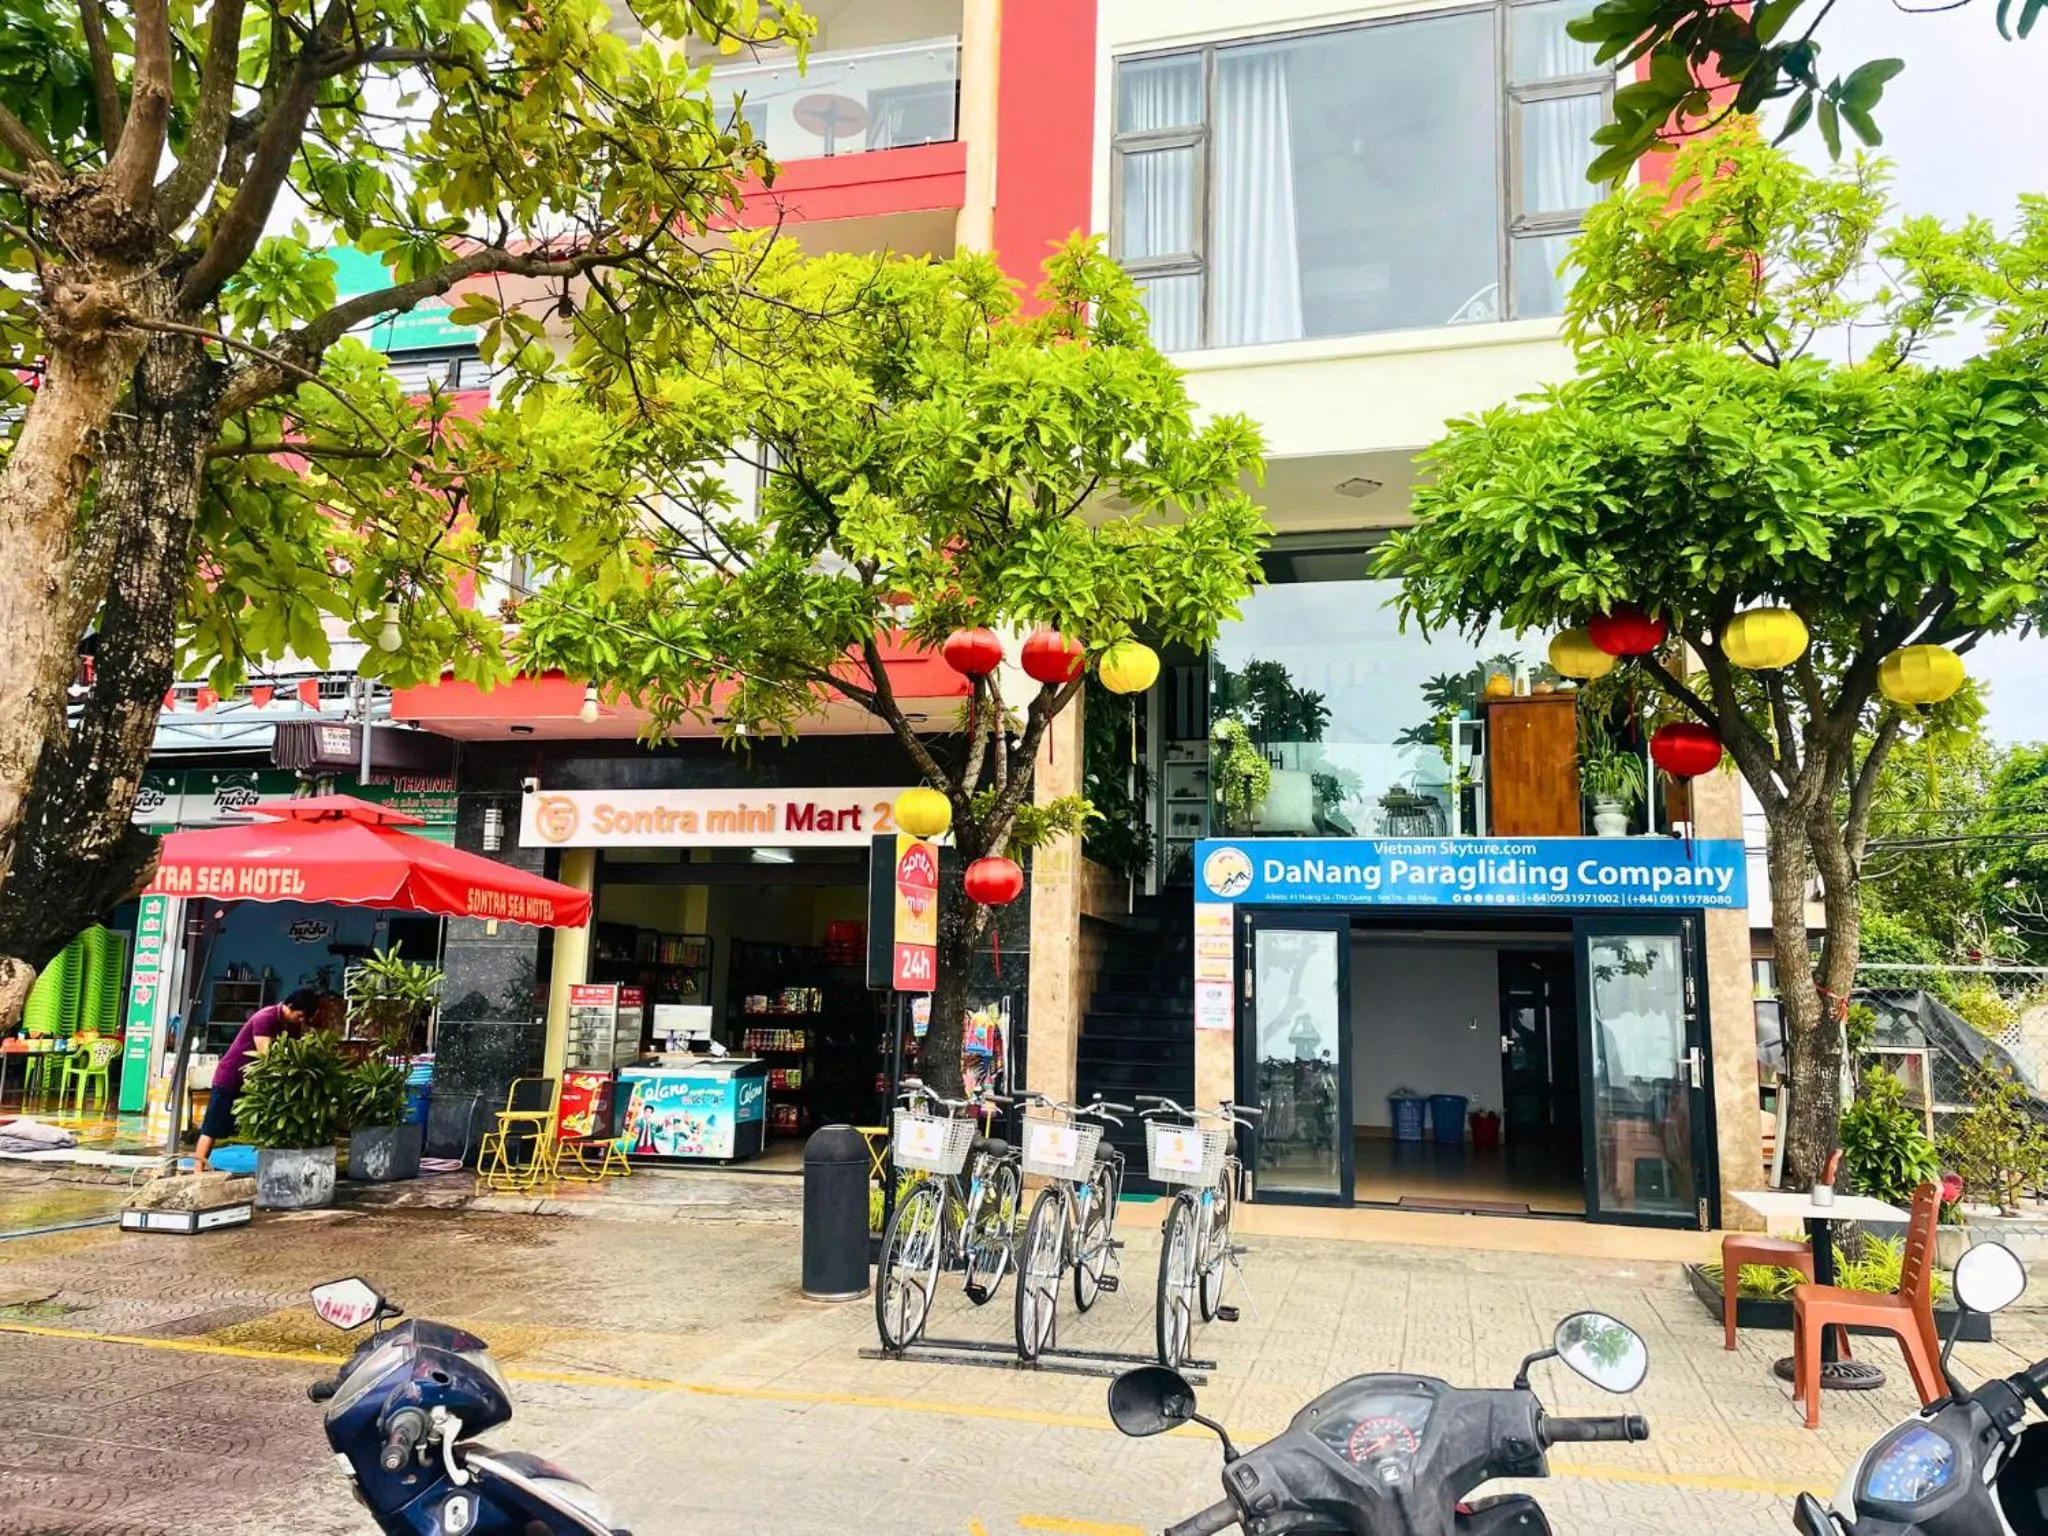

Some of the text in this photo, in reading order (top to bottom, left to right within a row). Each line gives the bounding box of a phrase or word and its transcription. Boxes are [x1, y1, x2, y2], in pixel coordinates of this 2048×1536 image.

[591, 803, 697, 834] Sontra
[705, 802, 777, 833] mini
[785, 802, 862, 833] Mart
[1374, 841, 1537, 858] Vietnam Skyture.com
[152, 865, 306, 895] TRA SEA HOTEL
[901, 852, 935, 886] Sontra
[1263, 859, 1381, 890] DaNang
[1391, 858, 1569, 891] Paragliding
[1577, 859, 1735, 892] Company
[467, 887, 555, 922] SONTRA SEA HOTEL
[905, 892, 928, 910] mini
[902, 950, 931, 979] 24h
